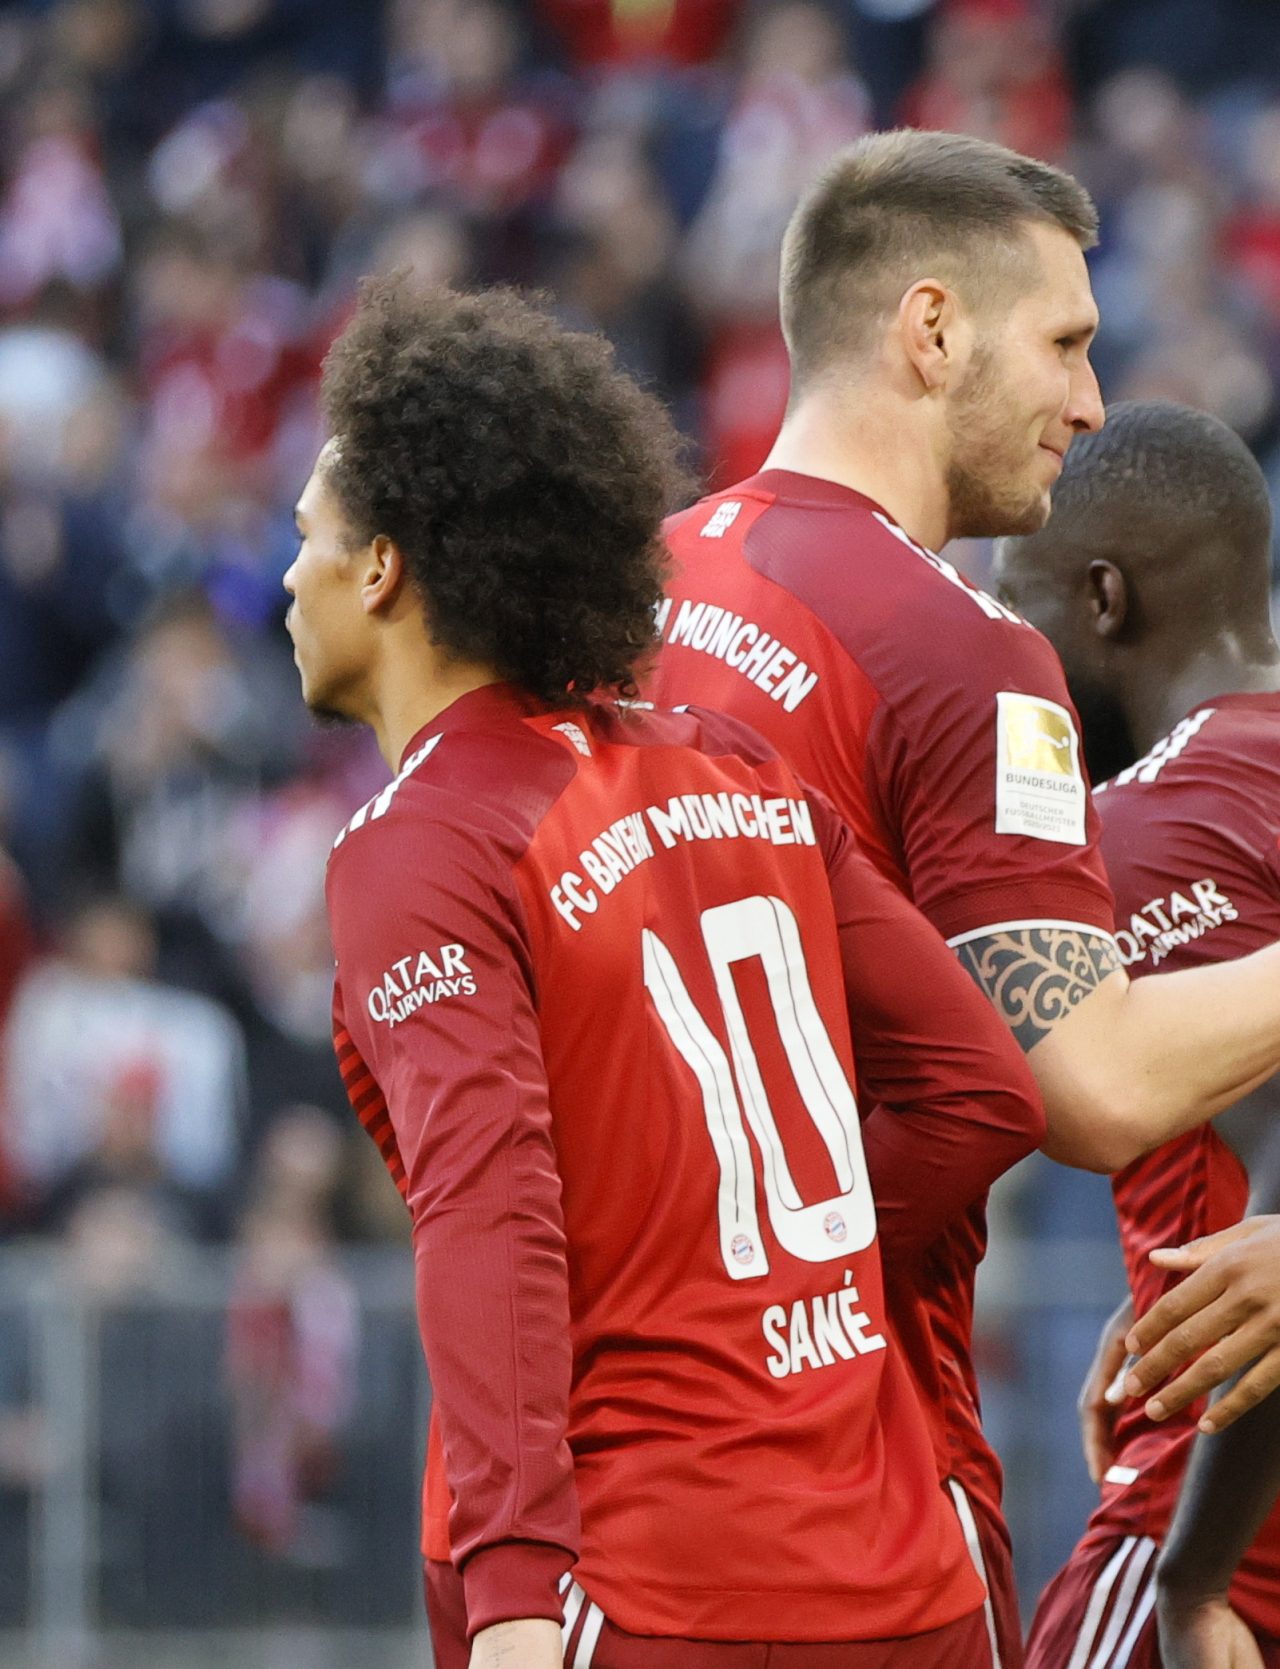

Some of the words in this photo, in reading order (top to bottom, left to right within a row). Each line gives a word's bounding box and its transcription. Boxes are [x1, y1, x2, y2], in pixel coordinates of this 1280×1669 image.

[667, 600, 819, 713] MÜNCHEN
[1006, 773, 1078, 794] BUNDESLIGA
[550, 871, 599, 931] FC
[579, 811, 655, 895] BAYEN
[646, 792, 816, 849] MÜNCHEN
[1113, 878, 1229, 966] QATAR
[368, 943, 472, 1022] QATAR
[389, 975, 477, 1029] AIRWAYS
[641, 895, 878, 1280] 10
[761, 1268, 887, 1379] SANÉ
